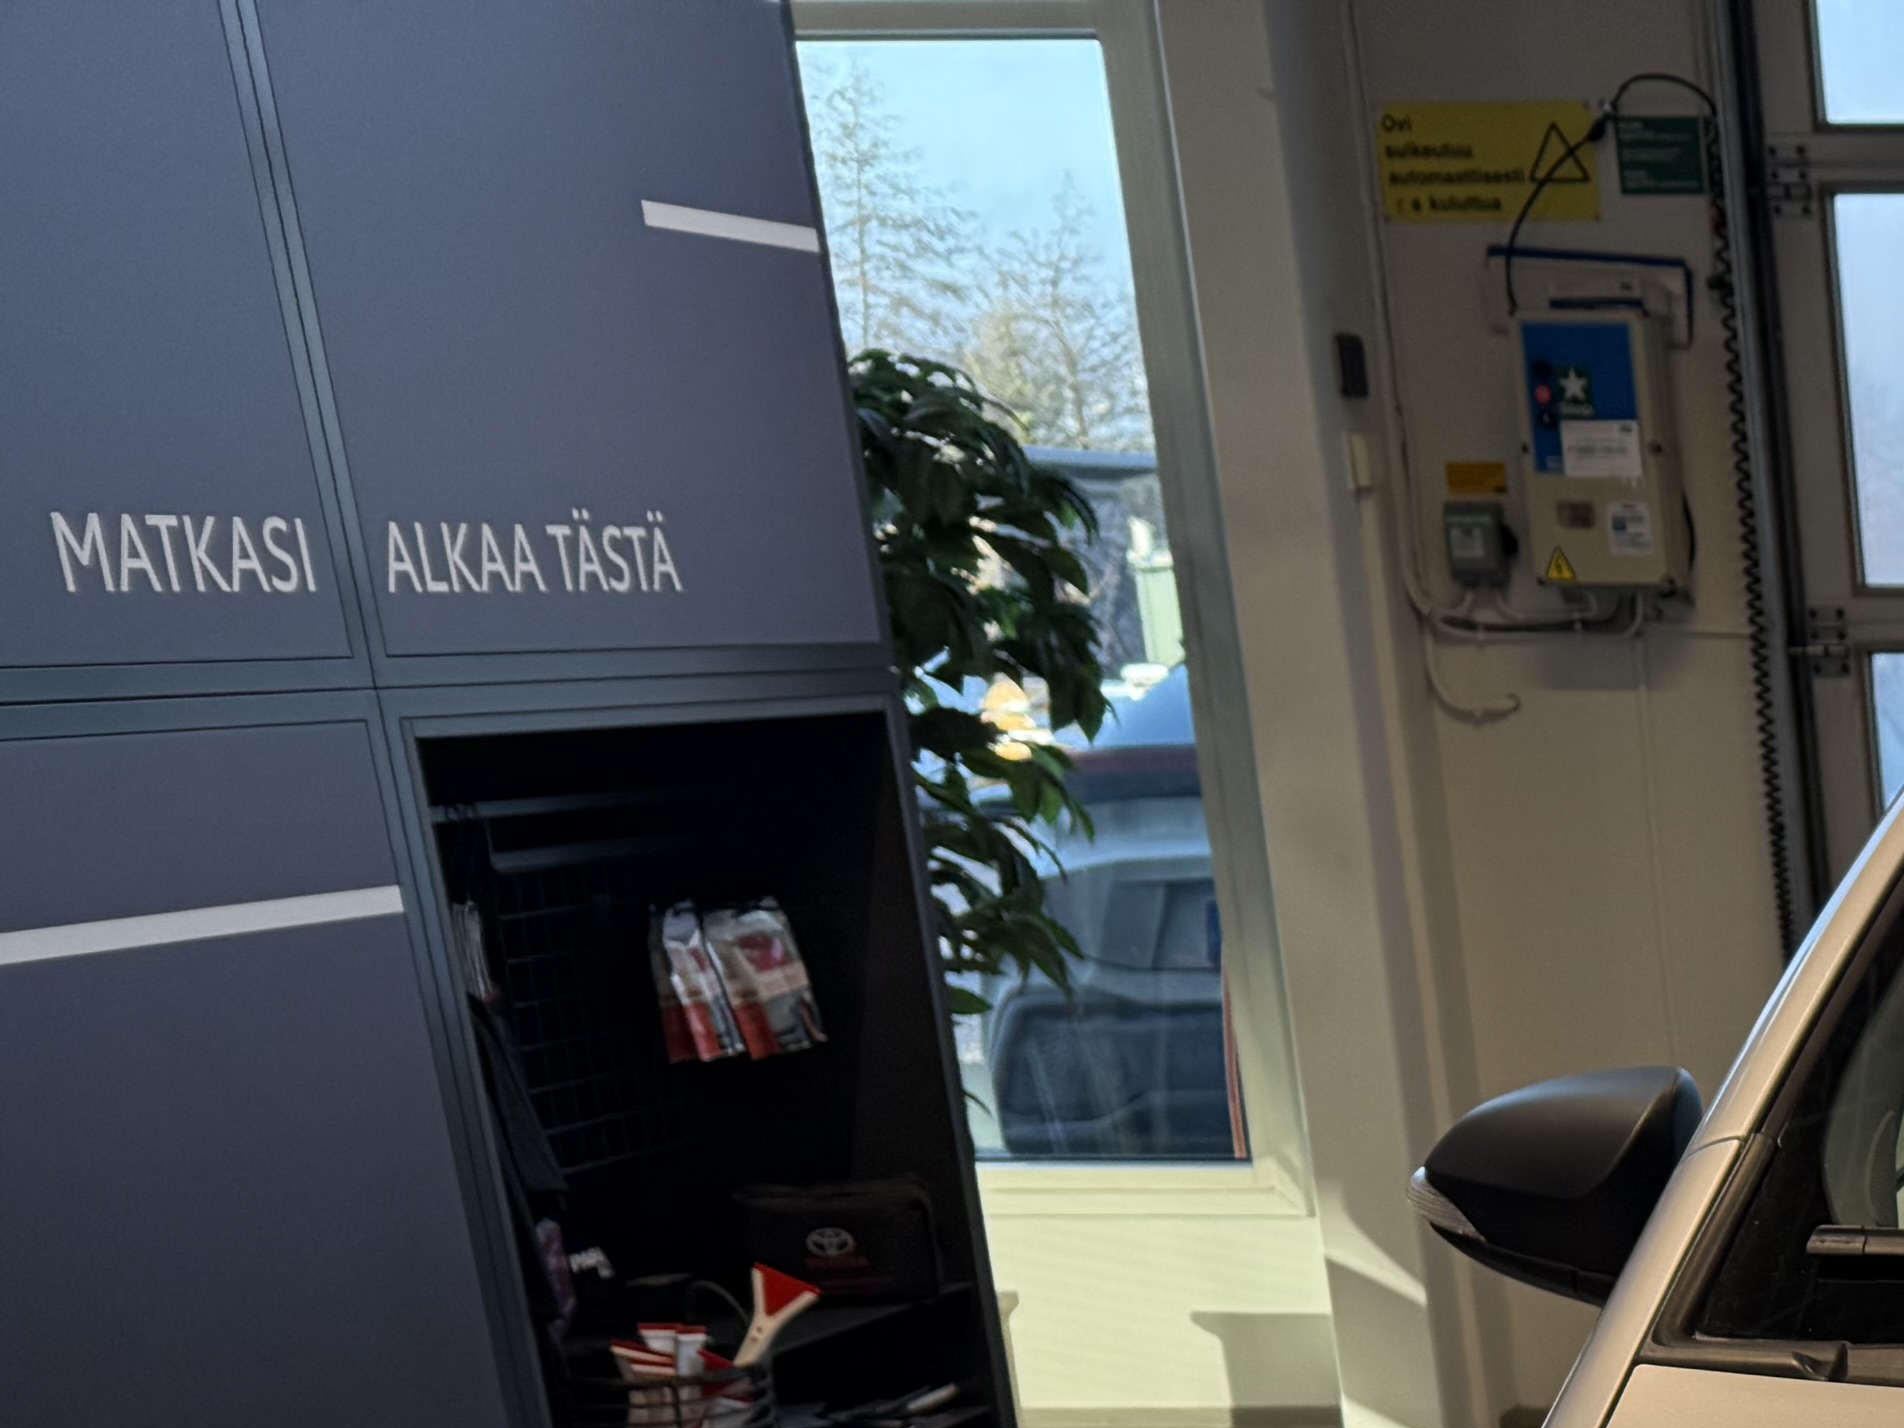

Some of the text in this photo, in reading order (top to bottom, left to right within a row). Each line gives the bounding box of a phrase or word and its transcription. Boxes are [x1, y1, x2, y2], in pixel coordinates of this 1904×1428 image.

[1381, 113, 1412, 132] Ovi
[50, 507, 684, 593] MATKASI ALKAA TÄSTÄ
